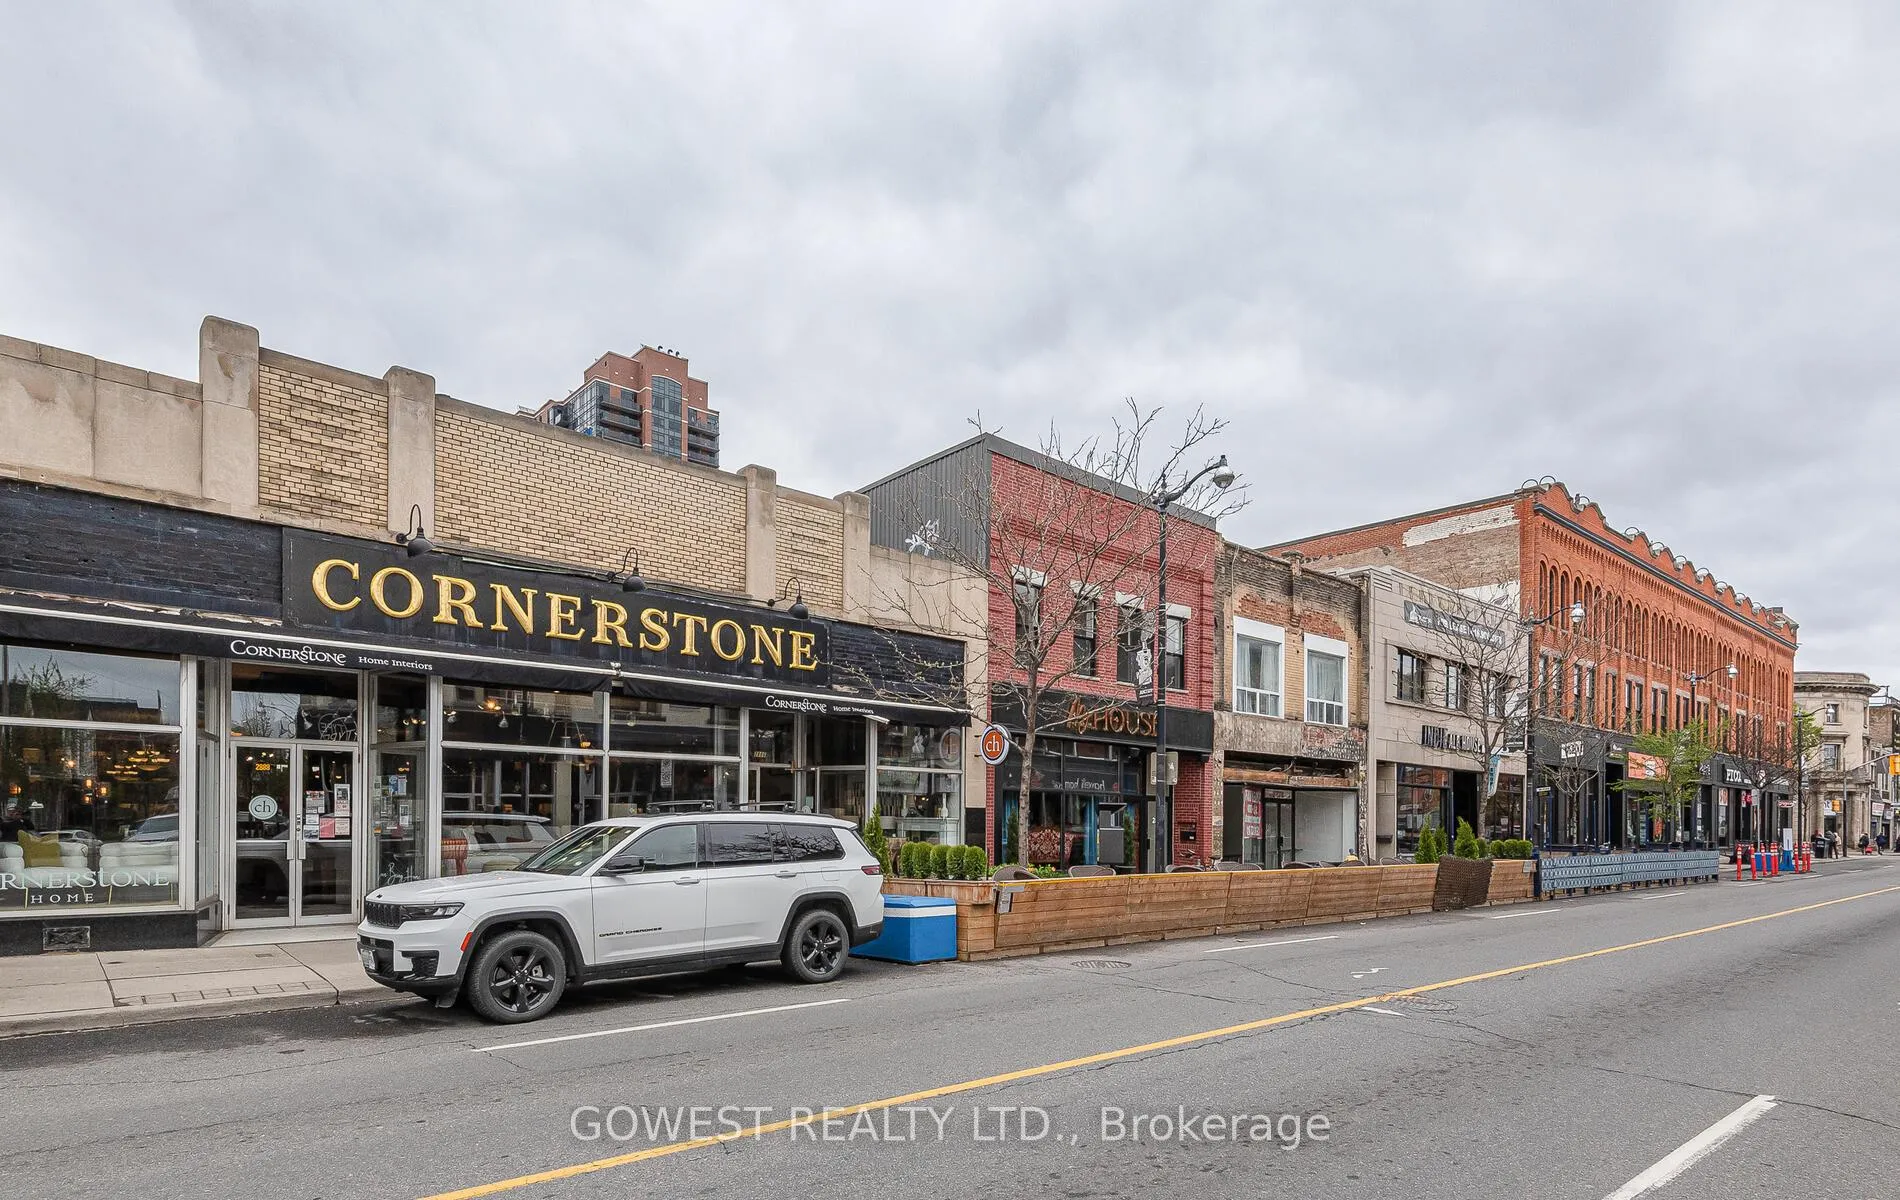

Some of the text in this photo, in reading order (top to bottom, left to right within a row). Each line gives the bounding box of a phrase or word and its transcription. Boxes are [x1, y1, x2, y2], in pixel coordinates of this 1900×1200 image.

[311, 558, 818, 671] CORNERSTONE
[358, 656, 389, 668] Home
[391, 658, 433, 671] Interiors
[985, 735, 1000, 752] ch
[254, 801, 271, 813] ch
[31, 893, 94, 904] HOME
